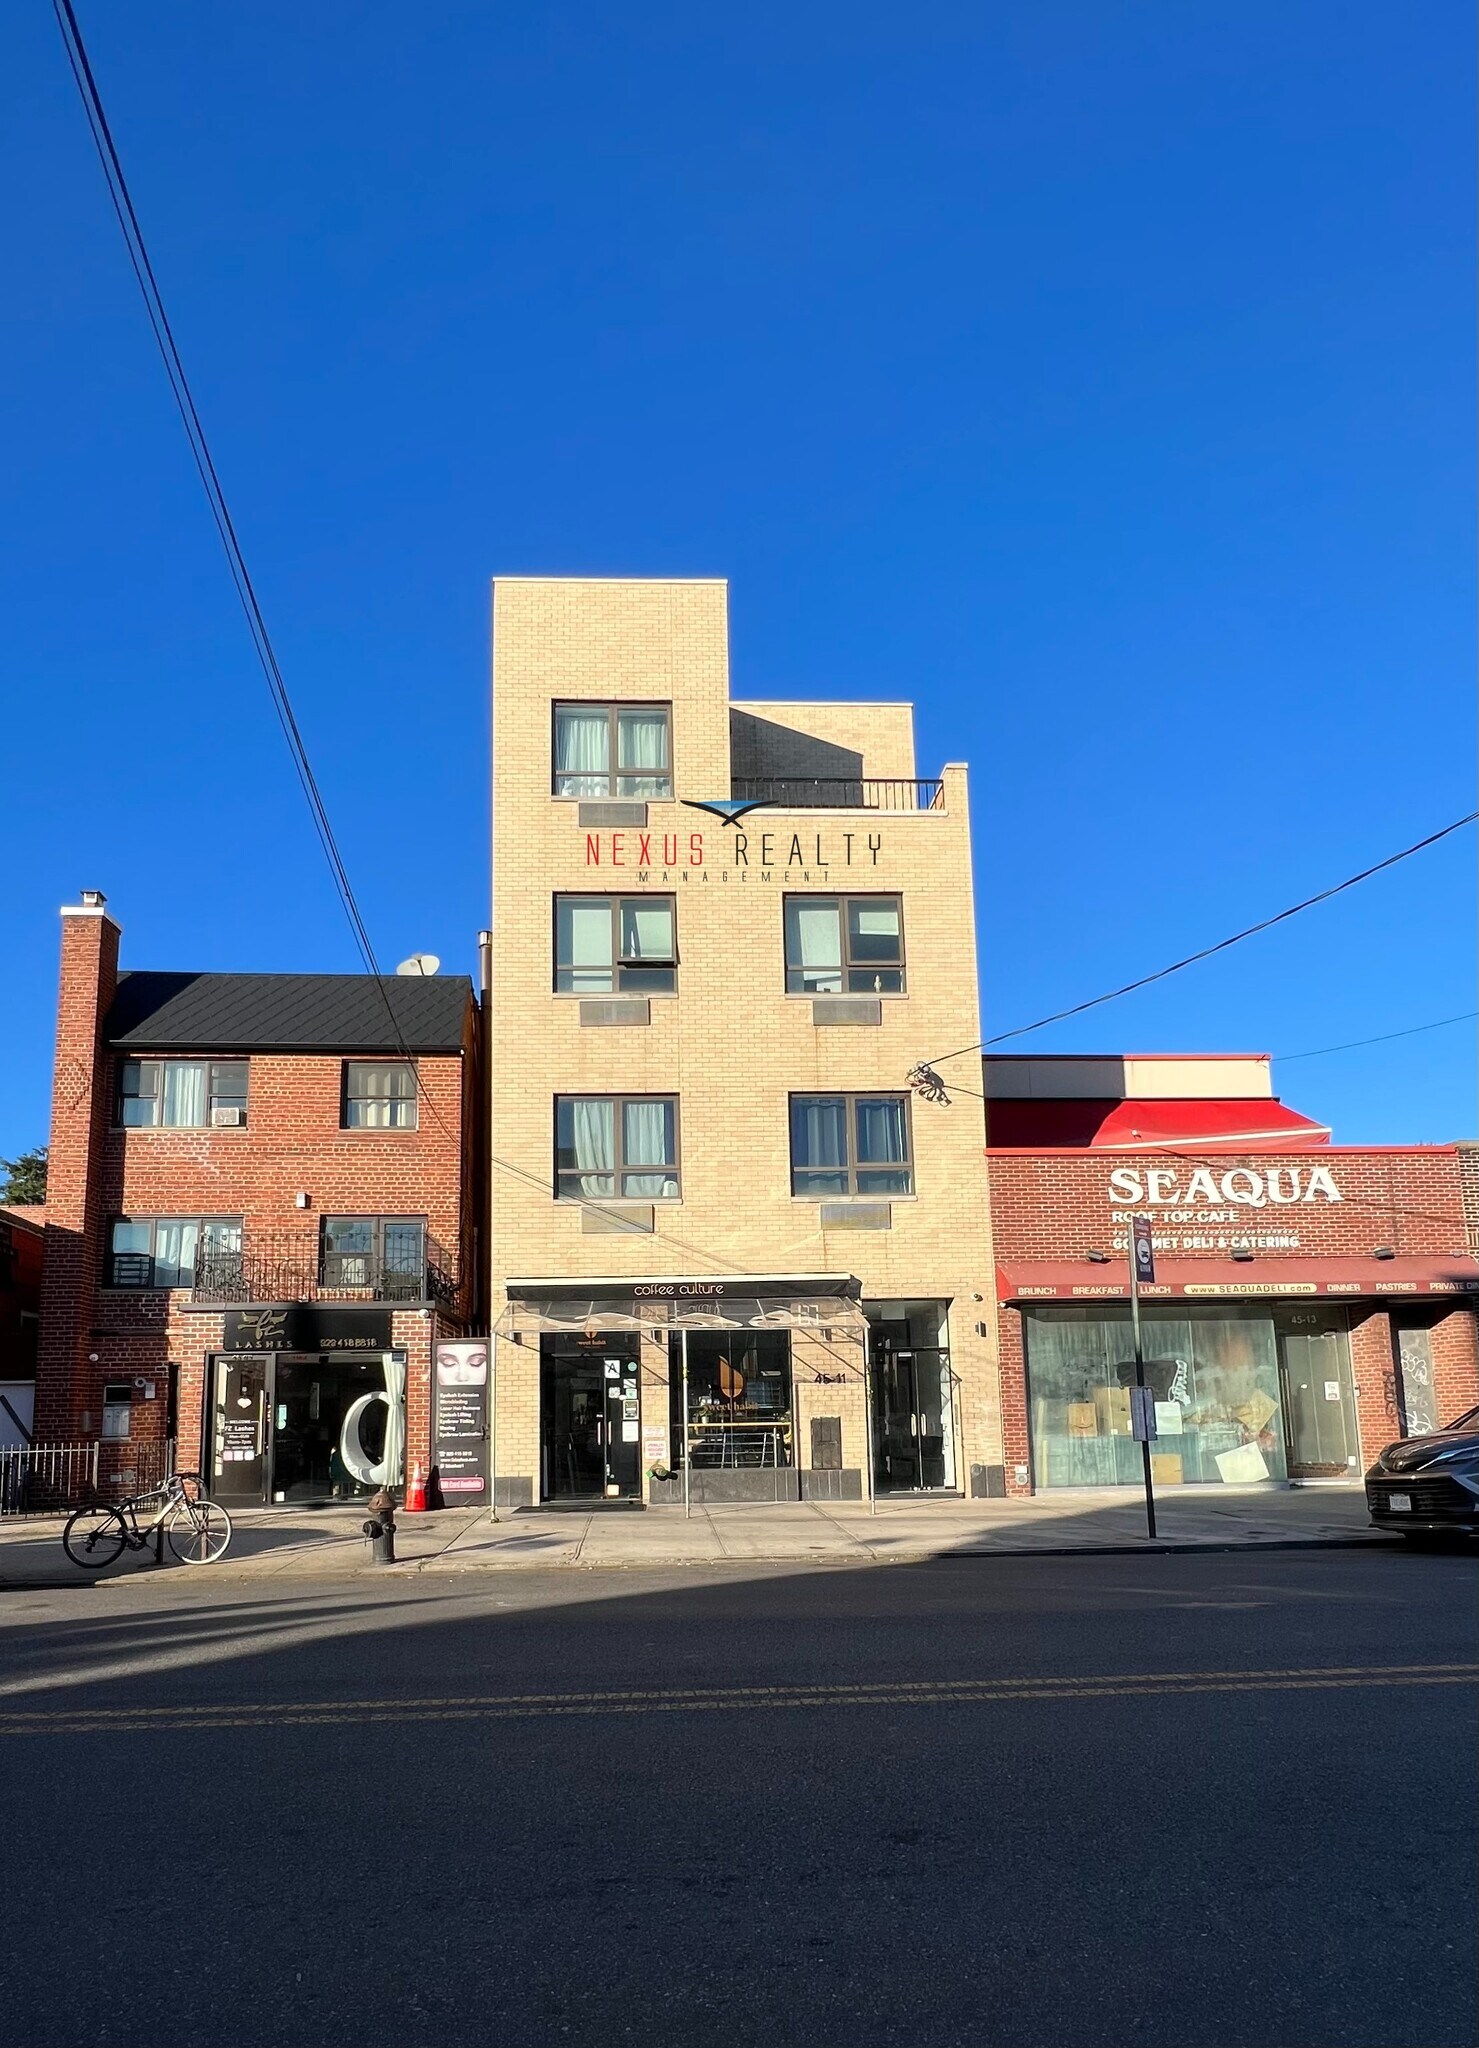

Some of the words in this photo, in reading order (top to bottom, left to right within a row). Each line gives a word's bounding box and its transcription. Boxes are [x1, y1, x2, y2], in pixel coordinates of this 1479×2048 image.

[587, 834, 703, 866] NEXUS
[735, 834, 881, 866] REALTY
[638, 870, 829, 882] MANAGEMENT
[1107, 1167, 1345, 1209] SEAQUA
[1112, 1210, 1157, 1223] ROOF
[1161, 1210, 1193, 1223] TOP
[1196, 1210, 1240, 1223] CAFE
[1112, 1237, 1179, 1249] GOMET
[1183, 1236, 1214, 1249] DELI
[1218, 1236, 1228, 1248] &
[1230, 1235, 1300, 1248] CATERING
[634, 1283, 675, 1296] coffee
[679, 1281, 725, 1295] culture
[1017, 1286, 1057, 1296] BRUNCH
[1072, 1286, 1125, 1295] BREAKFAST
[1139, 1285, 1171, 1295] LUNCH
[1327, 1283, 1361, 1292] DINNER
[1375, 1282, 1418, 1291] PASTRIES
[1429, 1281, 1464, 1291] PRIVATE
[1291, 1314, 1317, 1324] 45-13
[235, 1340, 293, 1349] LASHES
[607, 1362, 617, 1374] A
